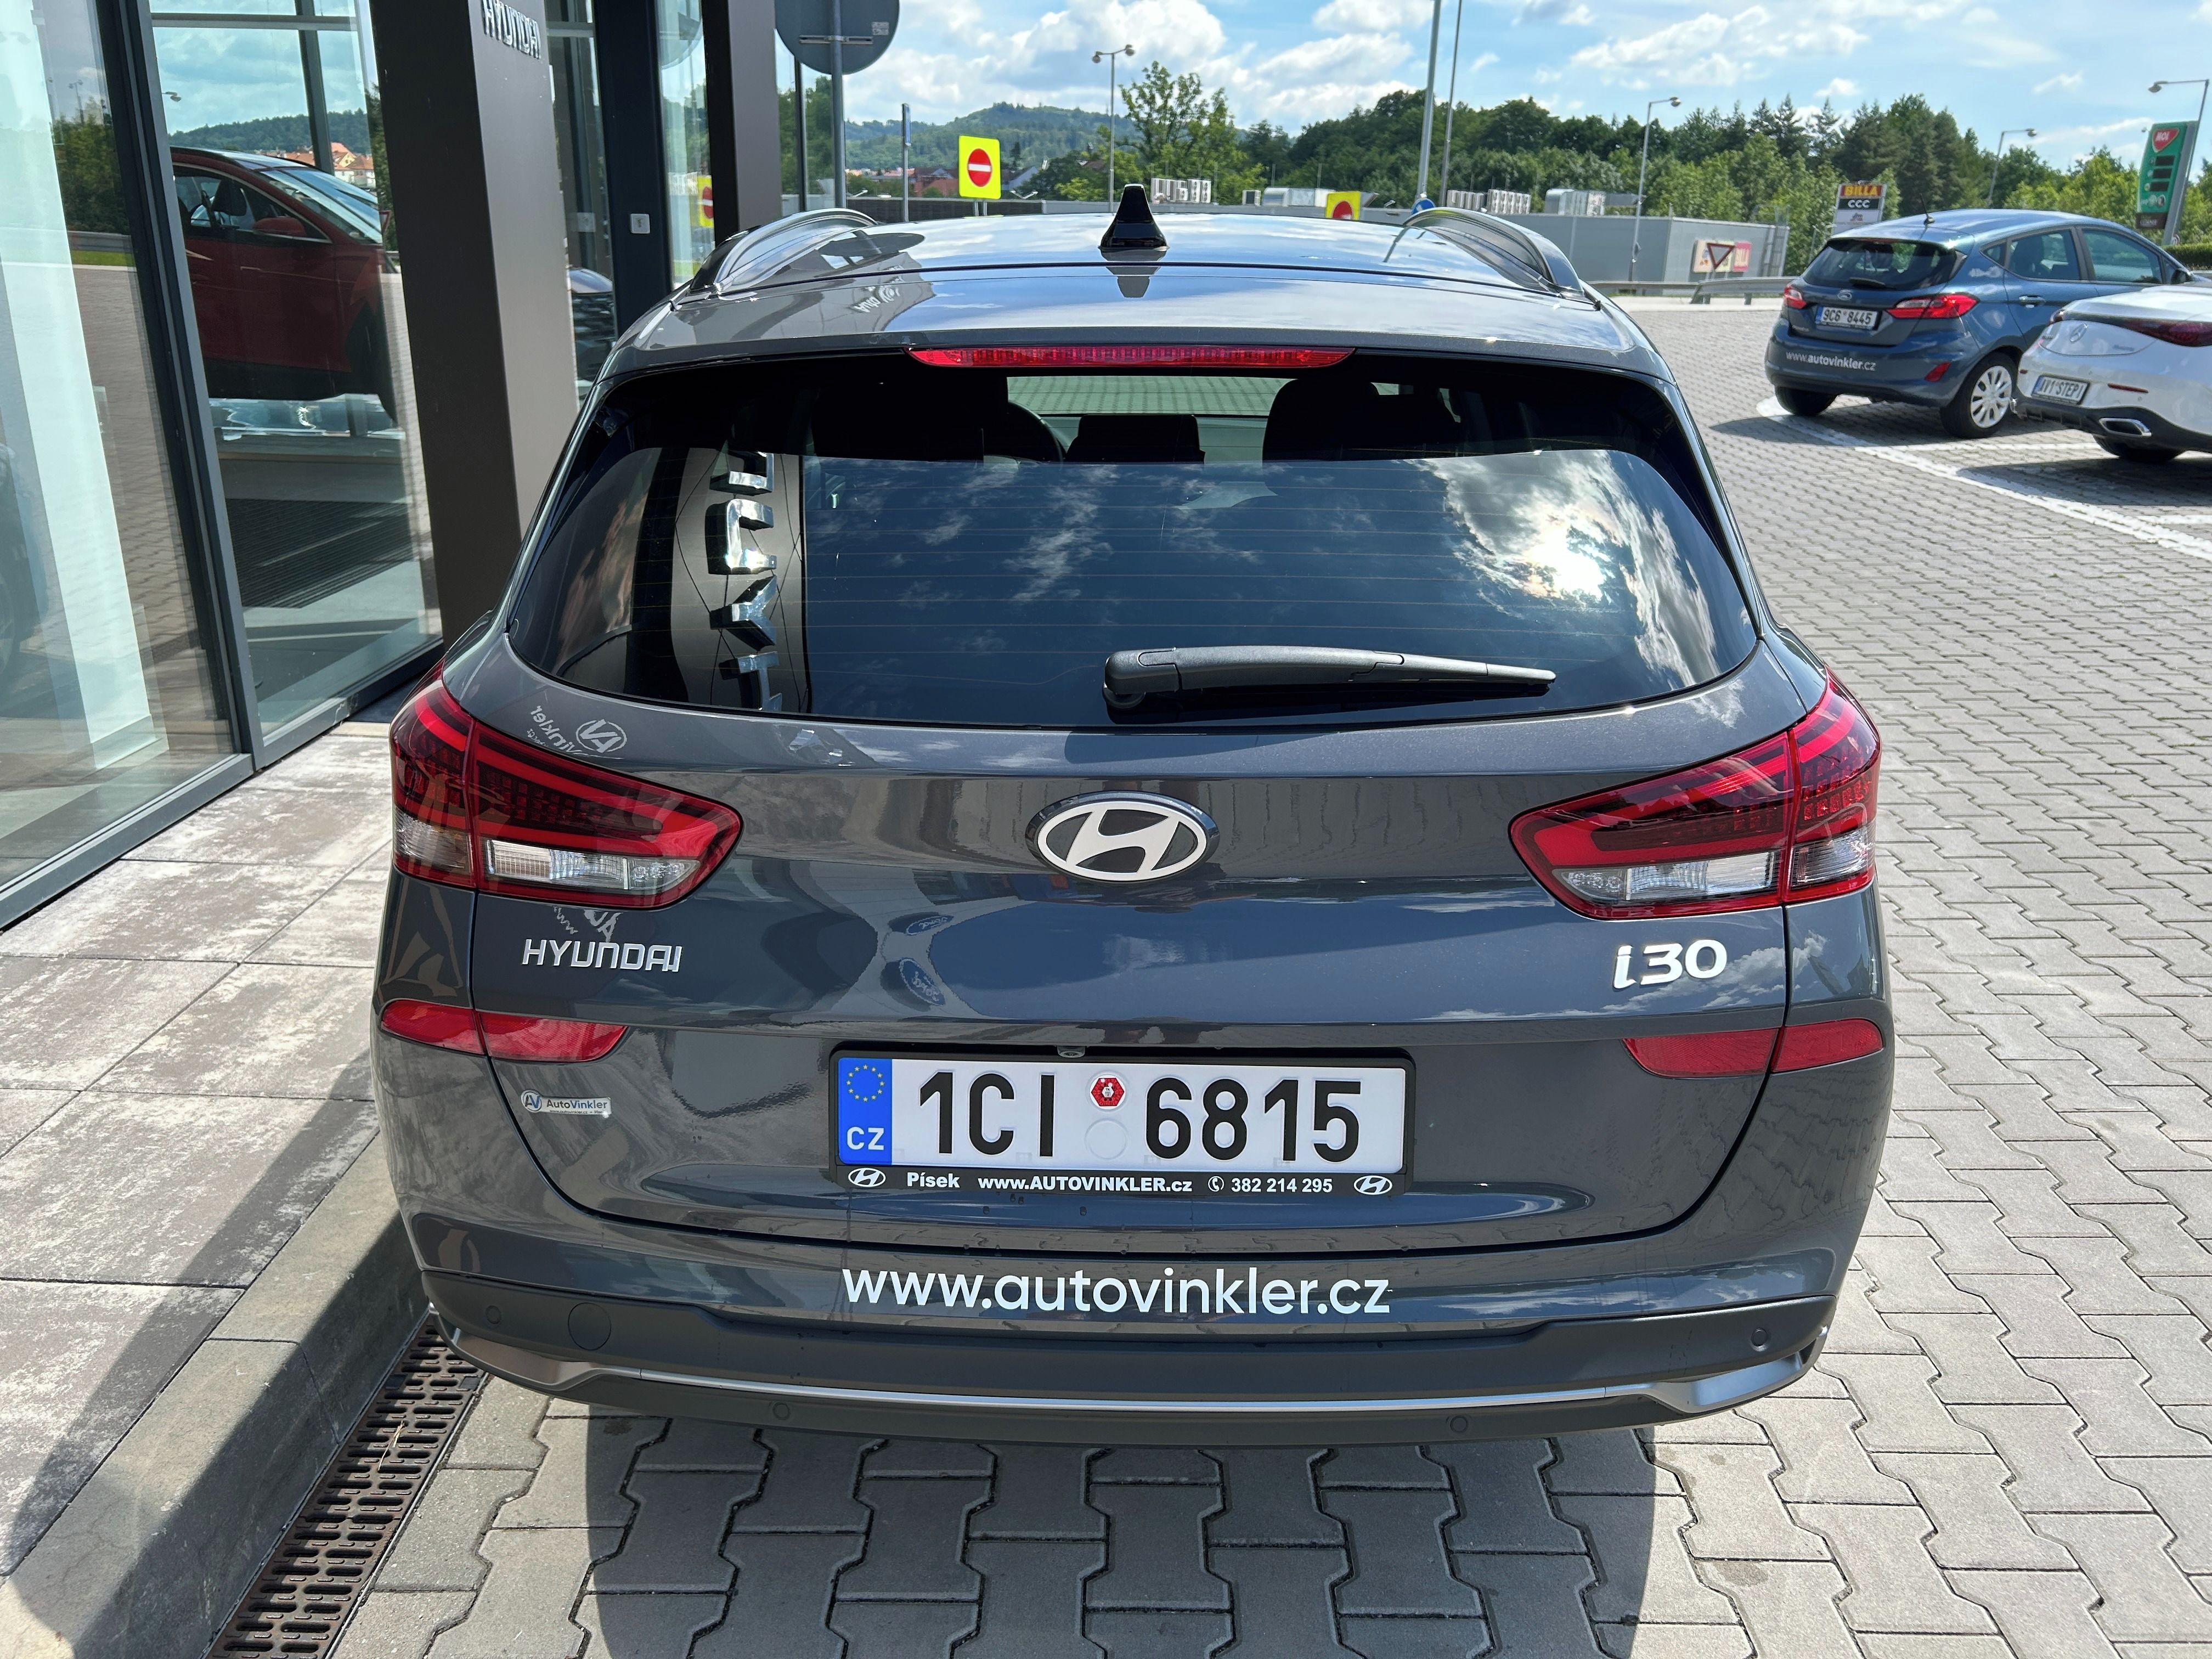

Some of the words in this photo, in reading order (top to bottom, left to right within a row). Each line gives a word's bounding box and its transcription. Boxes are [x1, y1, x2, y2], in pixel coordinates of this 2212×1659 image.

[481, 0, 541, 59] HYUNDAI
[1844, 185, 1878, 195] BILLA
[1848, 199, 1870, 208] CCC
[1823, 309, 1841, 321] 9C6
[1847, 311, 1873, 324] 8445
[1786, 352, 1876, 371] www.autovinkler.cz
[522, 939, 682, 972] HYUNDAI
[1613, 939, 1727, 989] i30
[546, 1099, 607, 1109] AutoVinkler
[1146, 1077, 1362, 1163] 6815
[847, 1126, 884, 1150] CZ
[907, 1172, 960, 1188] Písek
[978, 1176, 1193, 1192] www.AUTOVINKLER.cz
[1231, 1178, 1261, 1193] 382
[1266, 1178, 1297, 1193] 214
[1302, 1180, 1333, 1193] 295
[842, 1267, 1390, 1314] www.autovinkler.cz
